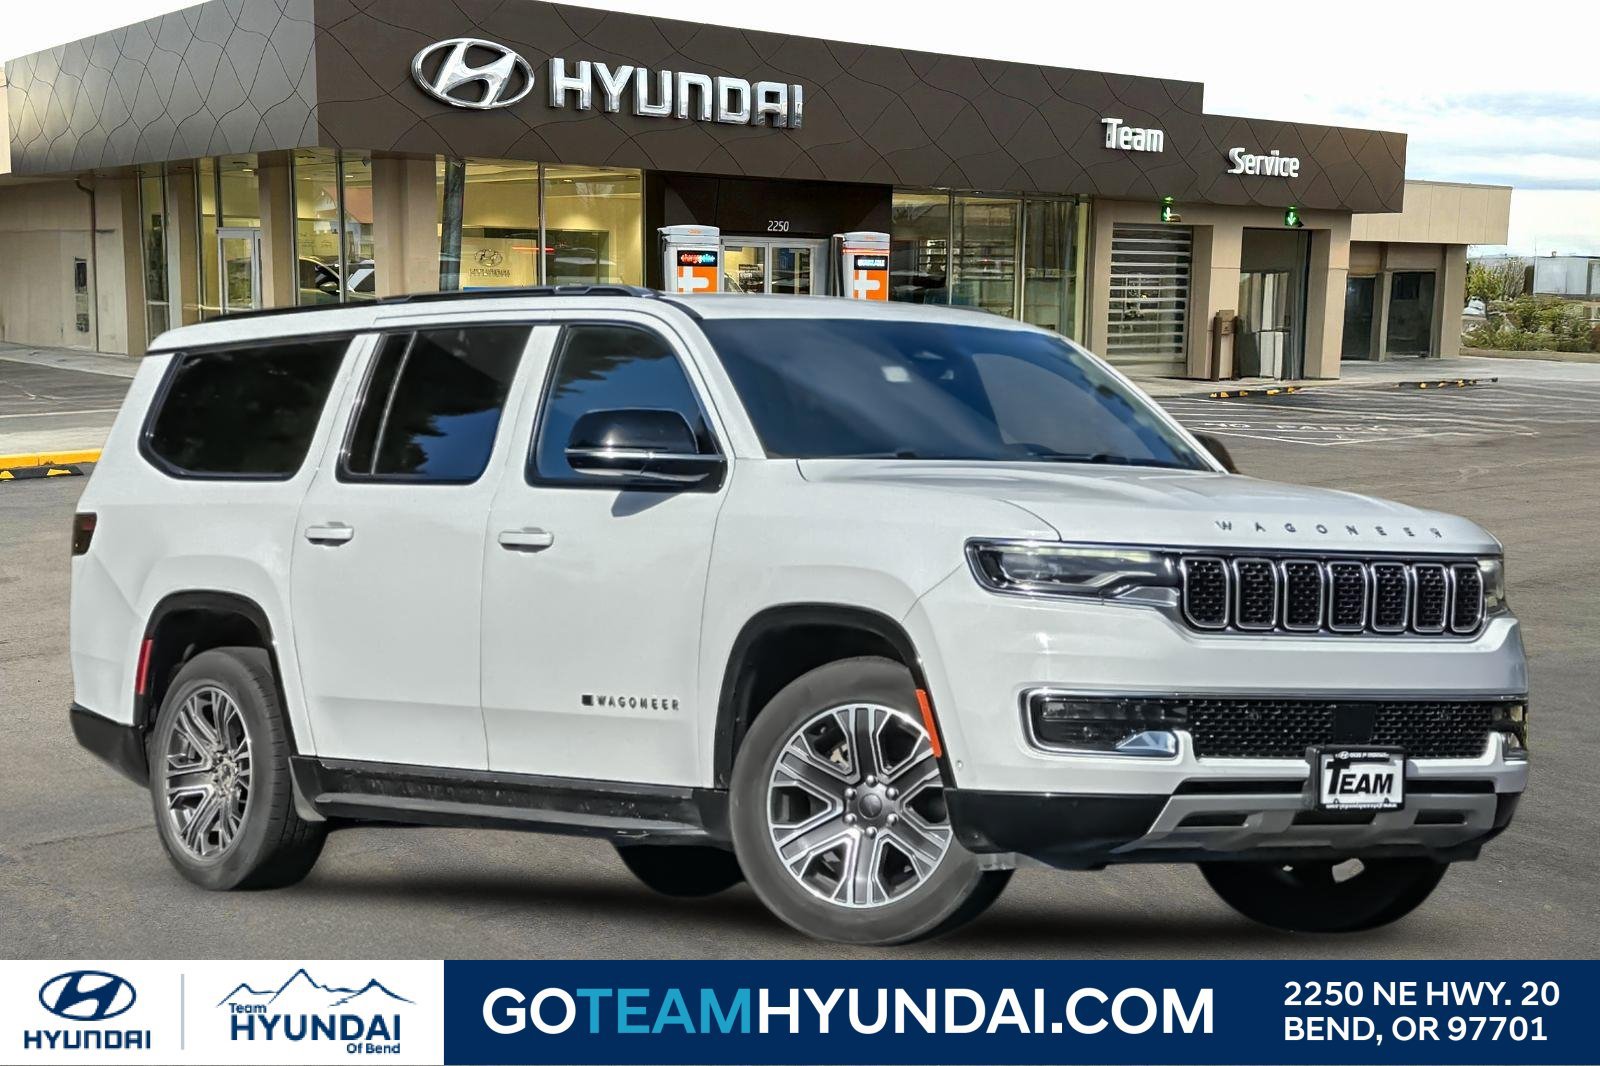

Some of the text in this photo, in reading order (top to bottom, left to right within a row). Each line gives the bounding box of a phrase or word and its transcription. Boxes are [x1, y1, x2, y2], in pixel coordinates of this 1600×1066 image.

[548, 57, 803, 129] HYUNDAI
[1101, 117, 1164, 152] Team
[1227, 147, 1300, 178] Service
[767, 220, 790, 232] 2250
[1215, 519, 1442, 538] WAGONEER
[597, 695, 679, 711] WAGONEER
[1325, 758, 1394, 795] TEAM
